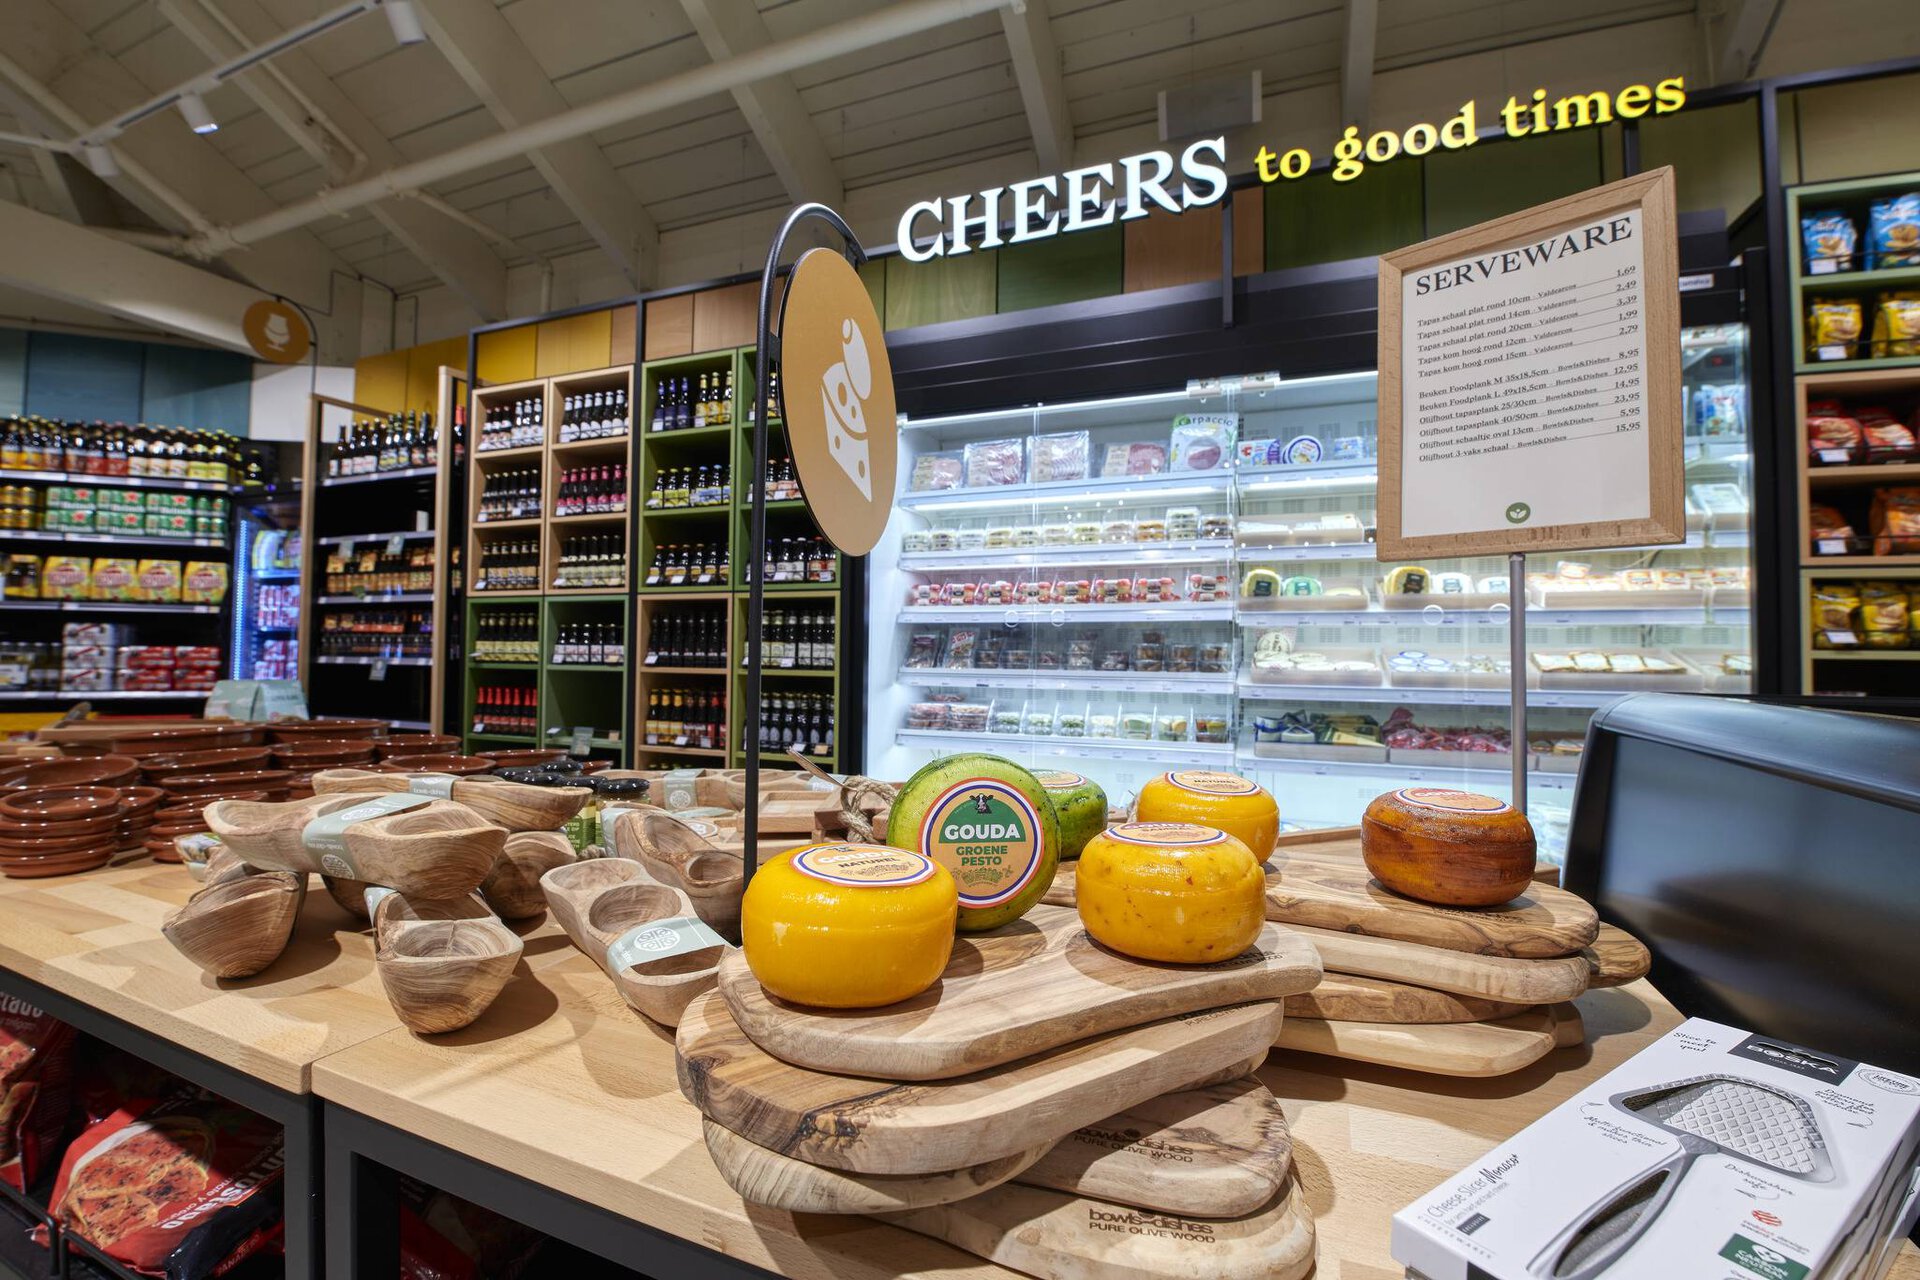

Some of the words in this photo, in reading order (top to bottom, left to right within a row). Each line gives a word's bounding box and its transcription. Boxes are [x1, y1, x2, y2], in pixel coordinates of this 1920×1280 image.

[896, 135, 1228, 264] CHEERS
[1254, 145, 1312, 185] to
[1332, 99, 1480, 184] good
[1500, 74, 1686, 139] times
[1416, 217, 1633, 296] SERVEWARE
[1417, 317, 1440, 327] Tapas
[1442, 310, 1466, 320] schaal
[1468, 305, 1484, 316] plat
[1486, 300, 1506, 311] rond
[1508, 296, 1531, 306] 10cm
[1417, 330, 1442, 341] Tapas
[1442, 323, 1467, 334] schaal
[1468, 318, 1485, 329] plat
[1486, 313, 1506, 324] rond
[1508, 309, 1531, 320] 14cm
[1417, 343, 1442, 353] Tapas
[1443, 335, 1467, 347] schaal
[1469, 331, 1486, 342] plat
[1487, 326, 1506, 337] rond
[1508, 322, 1532, 333] 20cm
[1418, 356, 1443, 366] Tapas
[1442, 350, 1460, 360] kom
[1462, 346, 1482, 357] hoog
[1483, 341, 1503, 352] rond
[1505, 337, 1527, 347] 12cm
[1418, 369, 1442, 378] Tapas
[1443, 363, 1460, 373] kom
[1462, 359, 1482, 370] hoog
[1483, 355, 1503, 365] rond
[1506, 351, 1527, 361] 15cm
[1419, 388, 1447, 399] Beuken
[1449, 379, 1492, 394] Foodplank
[1493, 376, 1503, 385] M
[1419, 401, 1447, 412] Beuken
[1449, 392, 1492, 405] Foodplank
[1419, 413, 1453, 425] Olijfhout
[1455, 404, 1499, 418] tapasplank
[1500, 398, 1537, 411] 25/30cm
[1419, 426, 1453, 437] Olijfhout
[1455, 418, 1499, 431] tapasplank
[1419, 438, 1453, 450] Olijfhout
[1455, 432, 1491, 444] schaaltje
[1419, 451, 1453, 463] Olijfhout
[1482, 443, 1509, 454] schaal
[944, 823, 1021, 841] GOUDA
[818, 851, 895, 864] GOUDA
[838, 857, 902, 868] NATUREL
[956, 845, 1008, 856] GROENE
[961, 856, 1002, 867] PESTO
[1746, 1044, 1838, 1075] BOSKA
[1074, 1134, 1108, 1149] PURE
[1111, 1142, 1147, 1156] OLIVE
[1150, 1149, 1194, 1163] WOOD
[1427, 1192, 1467, 1218] Cheese
[1089, 1221, 1126, 1233] PURE
[1128, 1226, 1168, 1238] OLIVE
[1170, 1231, 1216, 1244] WOOD
